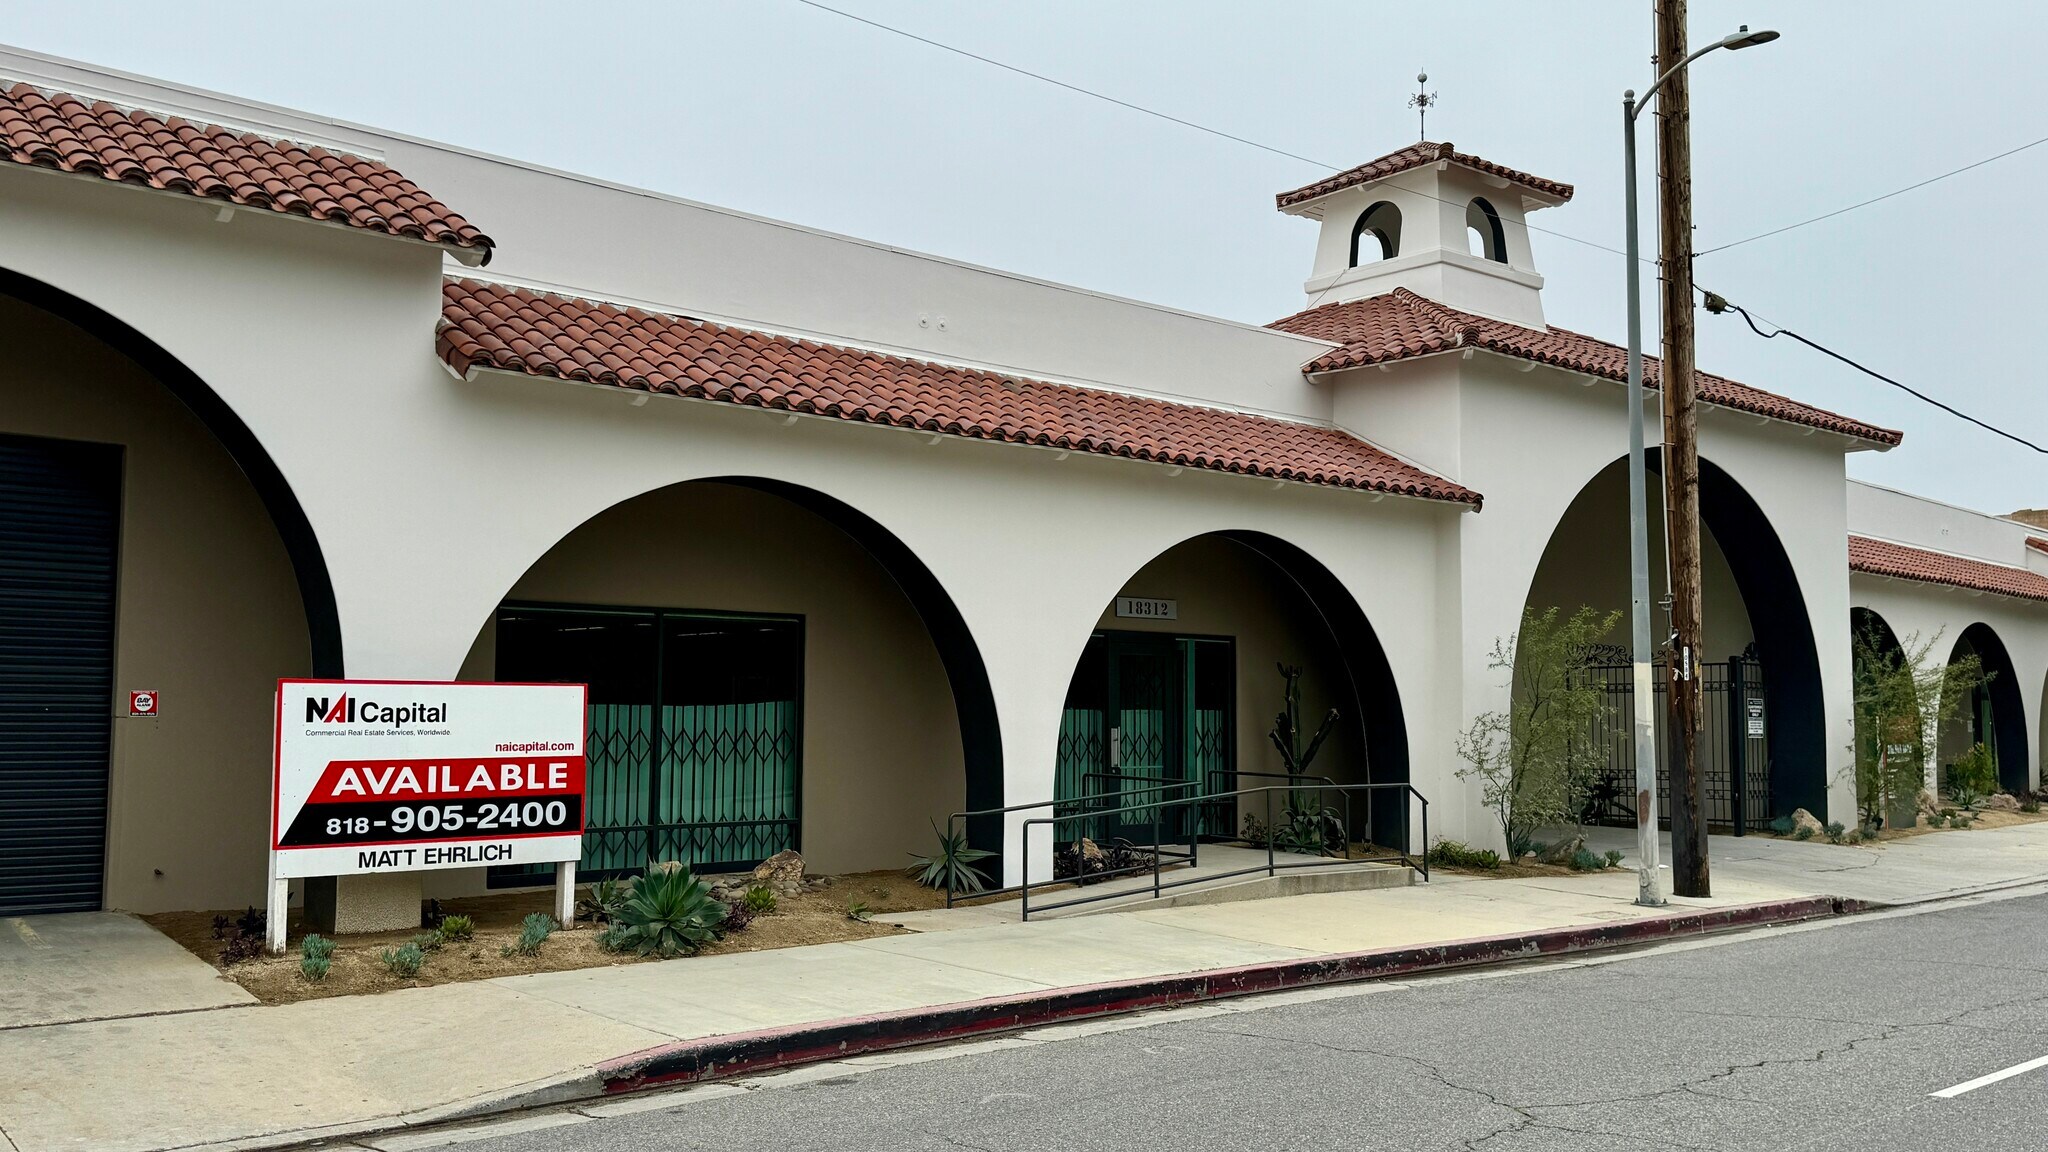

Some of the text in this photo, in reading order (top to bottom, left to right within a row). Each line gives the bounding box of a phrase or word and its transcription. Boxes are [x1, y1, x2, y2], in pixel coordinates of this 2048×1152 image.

[1128, 601, 1168, 616] 18312
[306, 692, 446, 728] NAI Capital
[495, 741, 575, 753] naicapital.com
[331, 763, 568, 796] AVAILABLE
[326, 801, 567, 835] 818-905-2400
[358, 844, 513, 868] MATT EHRLICH
